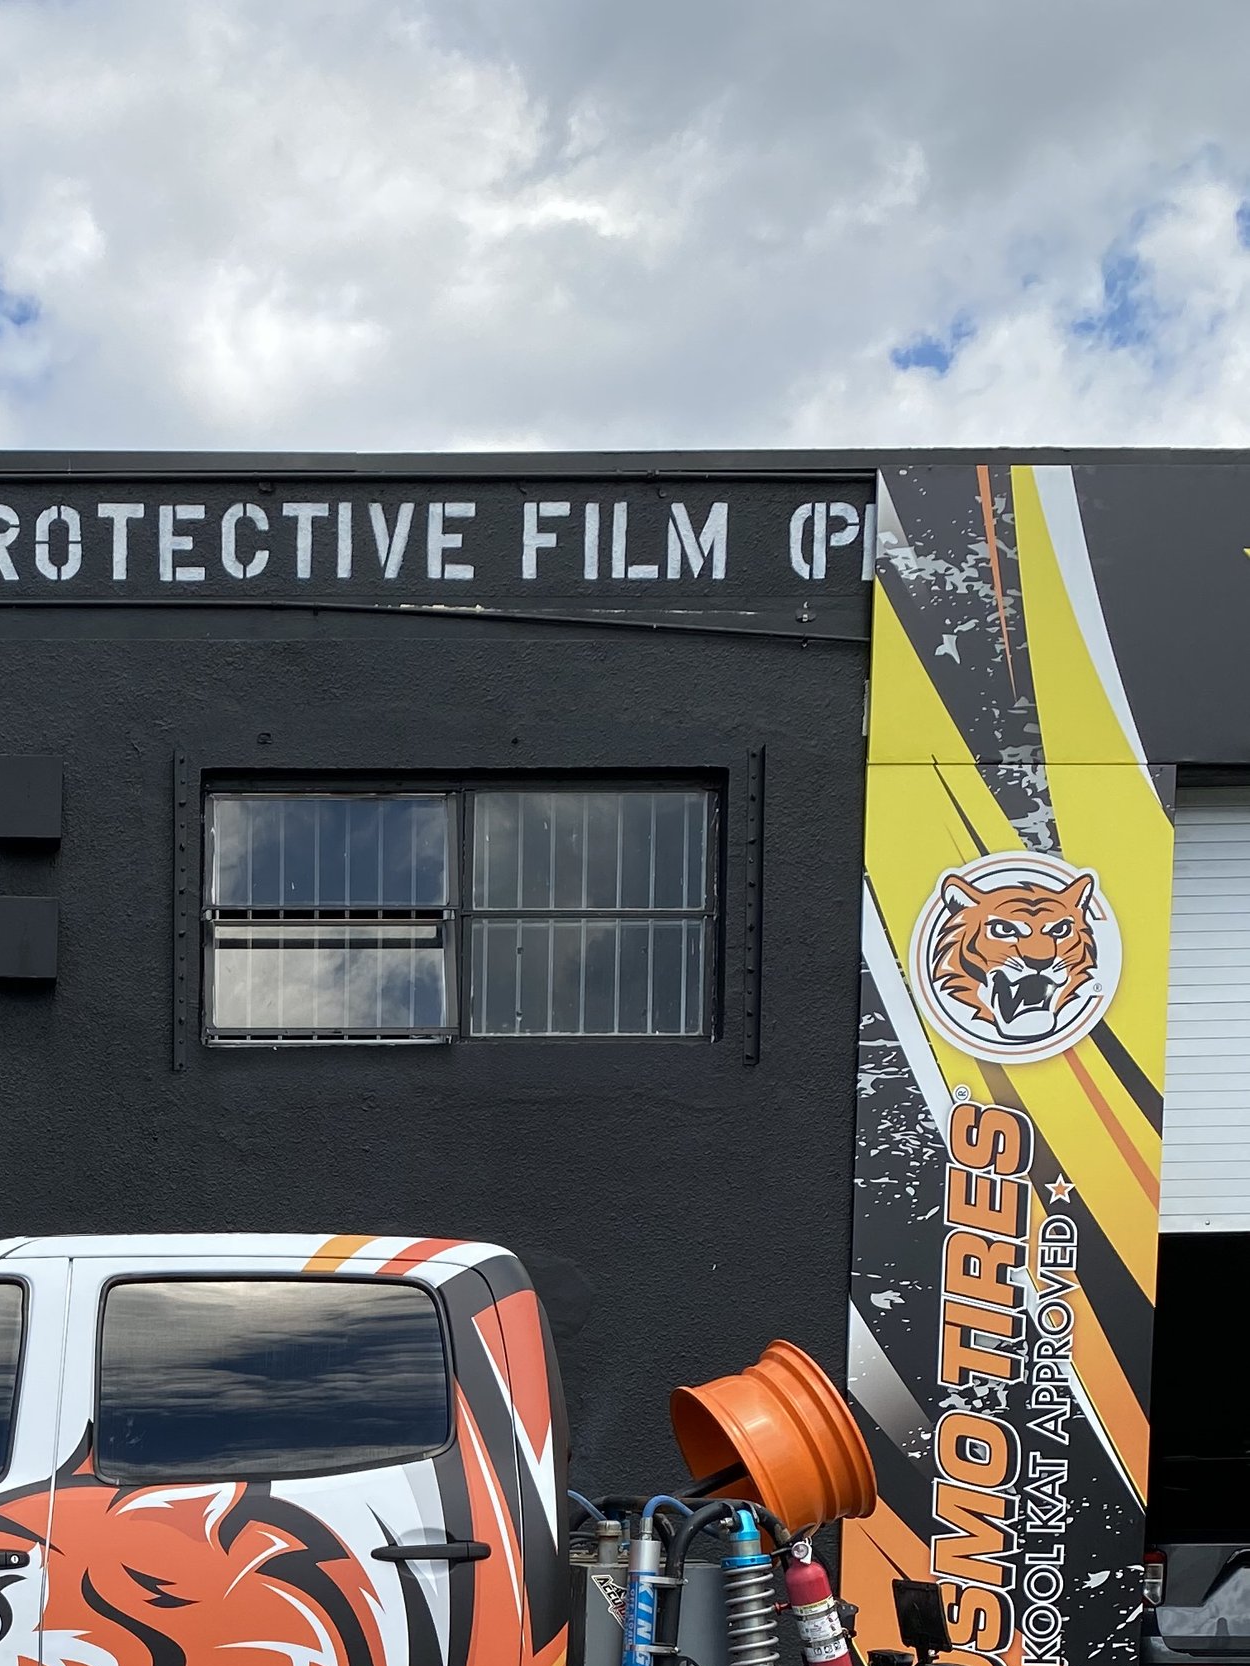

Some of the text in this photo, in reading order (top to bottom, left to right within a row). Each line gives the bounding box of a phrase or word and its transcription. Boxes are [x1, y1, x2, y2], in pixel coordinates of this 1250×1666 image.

[523, 502, 729, 580] FILM
[938, 1101, 1034, 1388] TIRES
[1020, 1214, 1080, 1666] KOOL KAT APPROVED
[636, 1580, 654, 1666] KING
